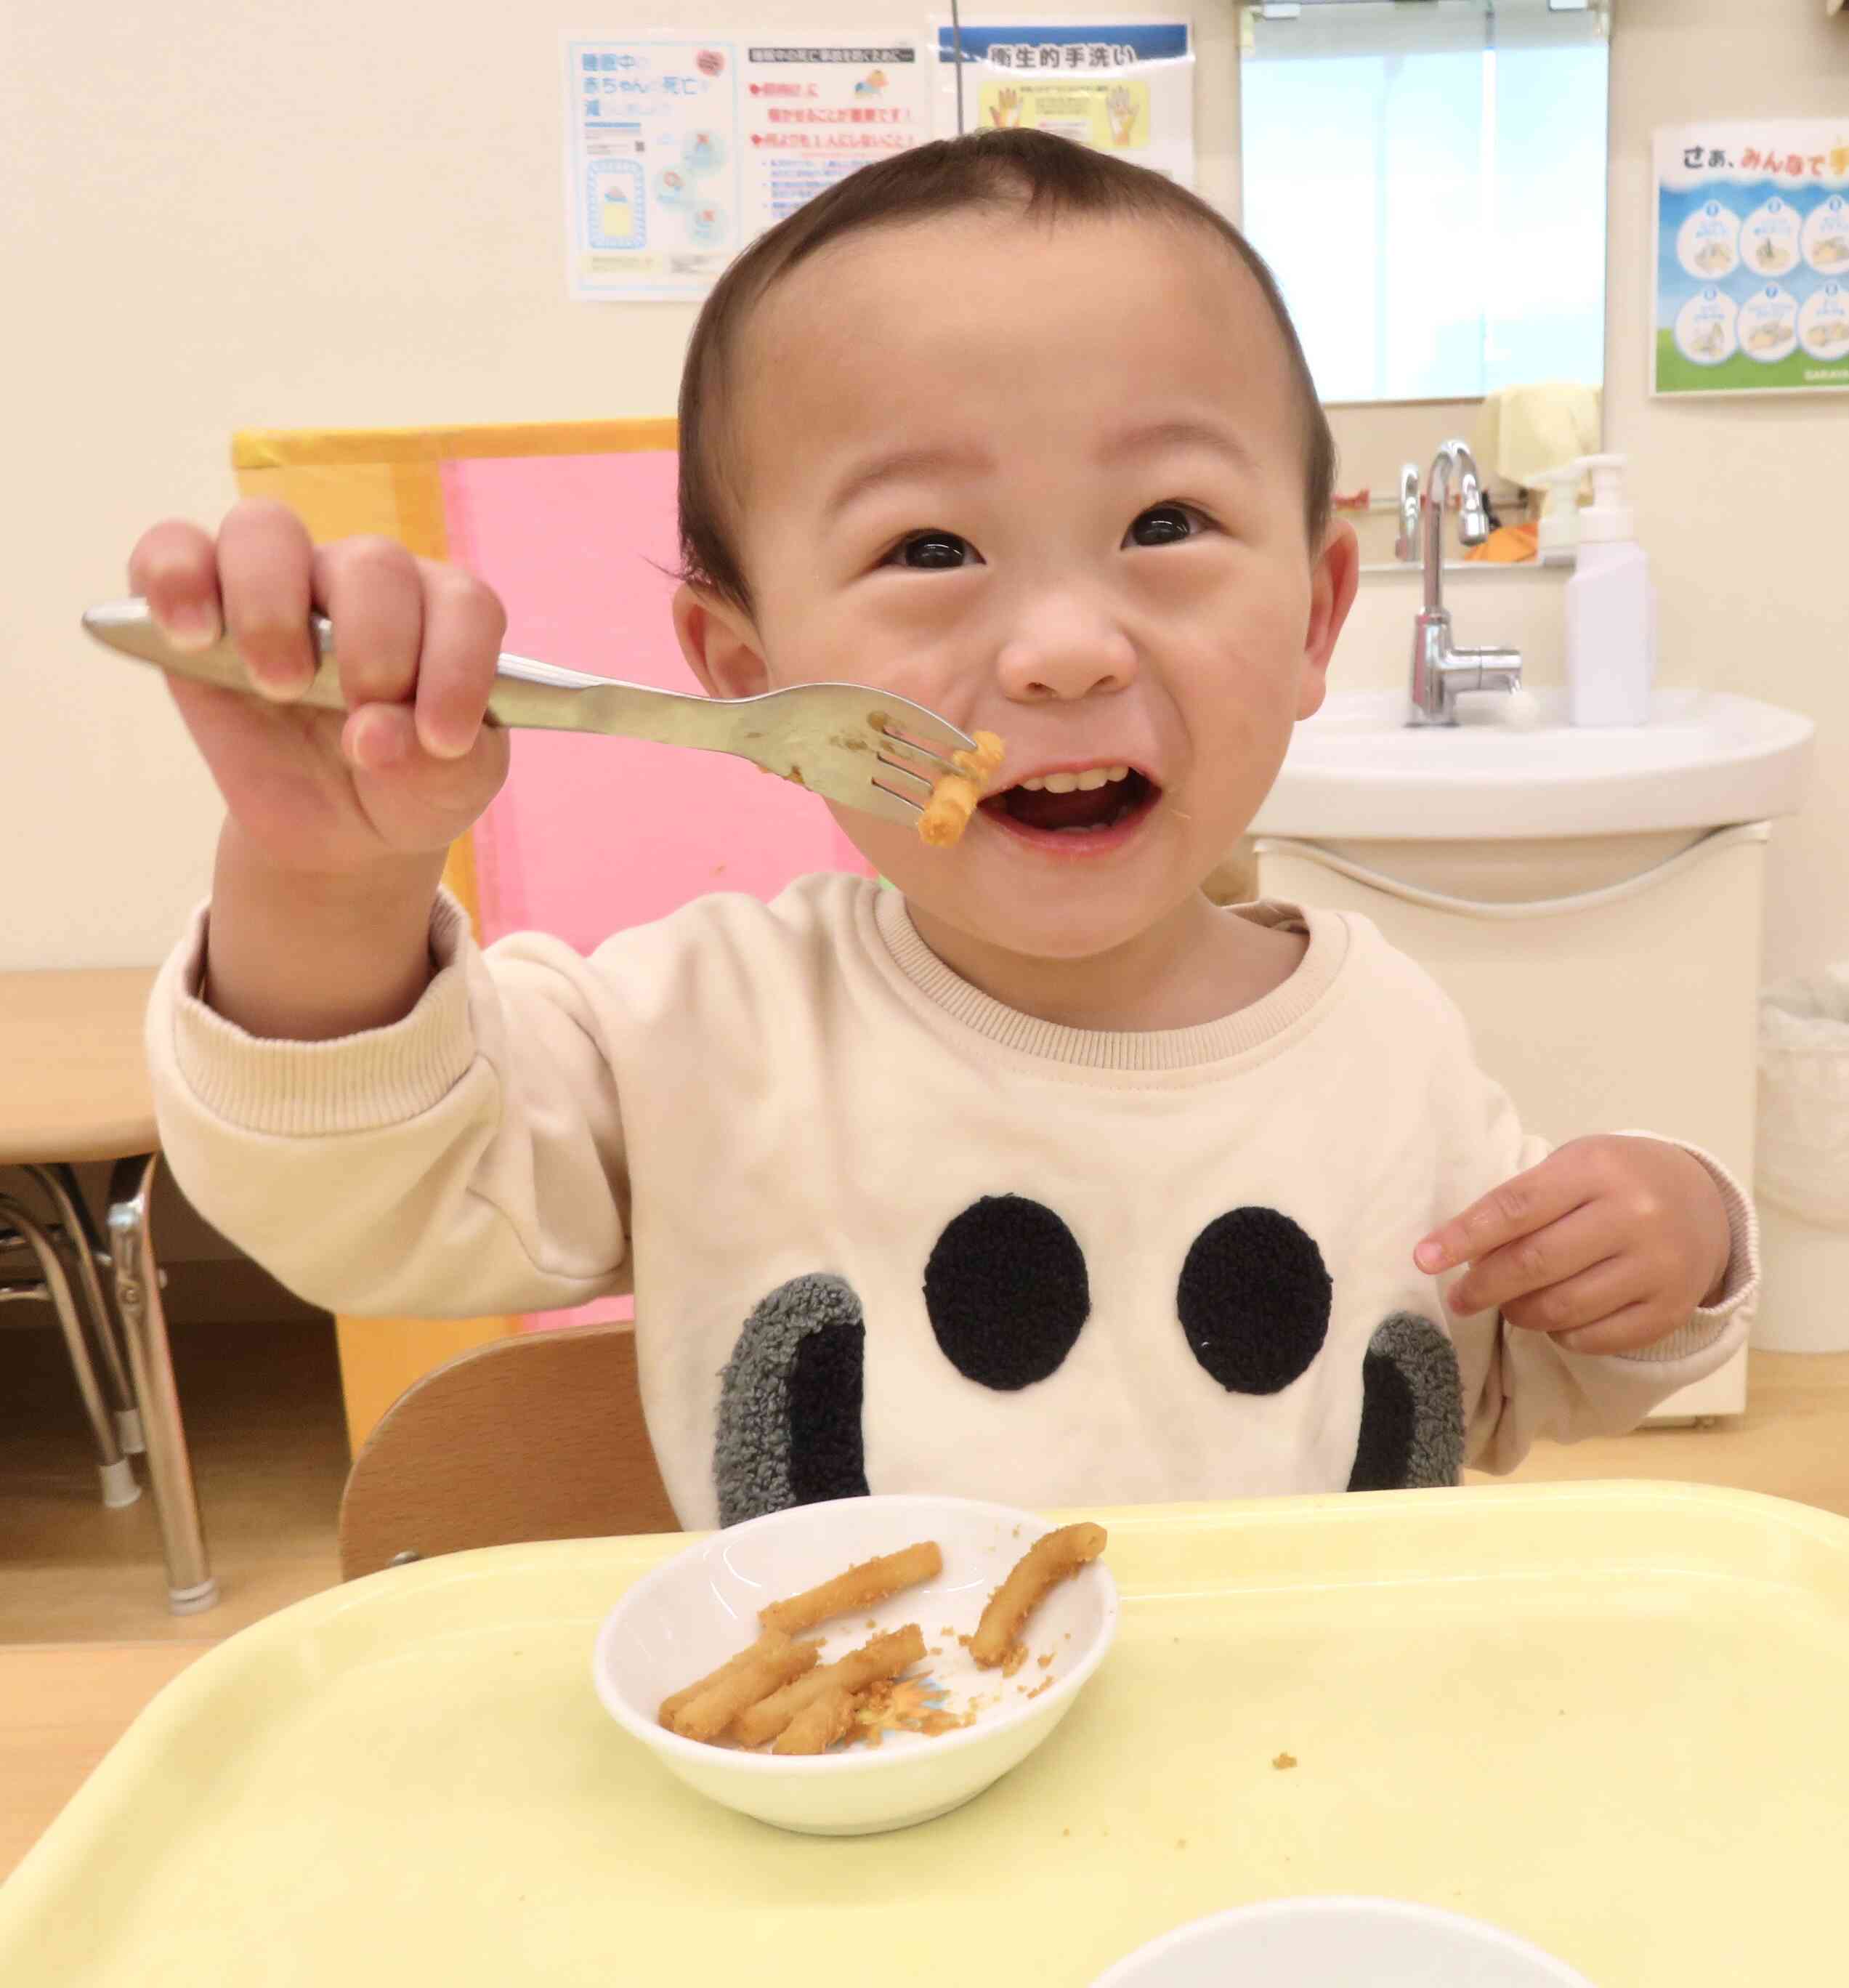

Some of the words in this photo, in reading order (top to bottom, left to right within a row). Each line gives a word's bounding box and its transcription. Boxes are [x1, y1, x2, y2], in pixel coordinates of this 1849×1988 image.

[581, 53, 650, 71] 睡眠中
[991, 46, 1134, 69] 衛生的手洗い
